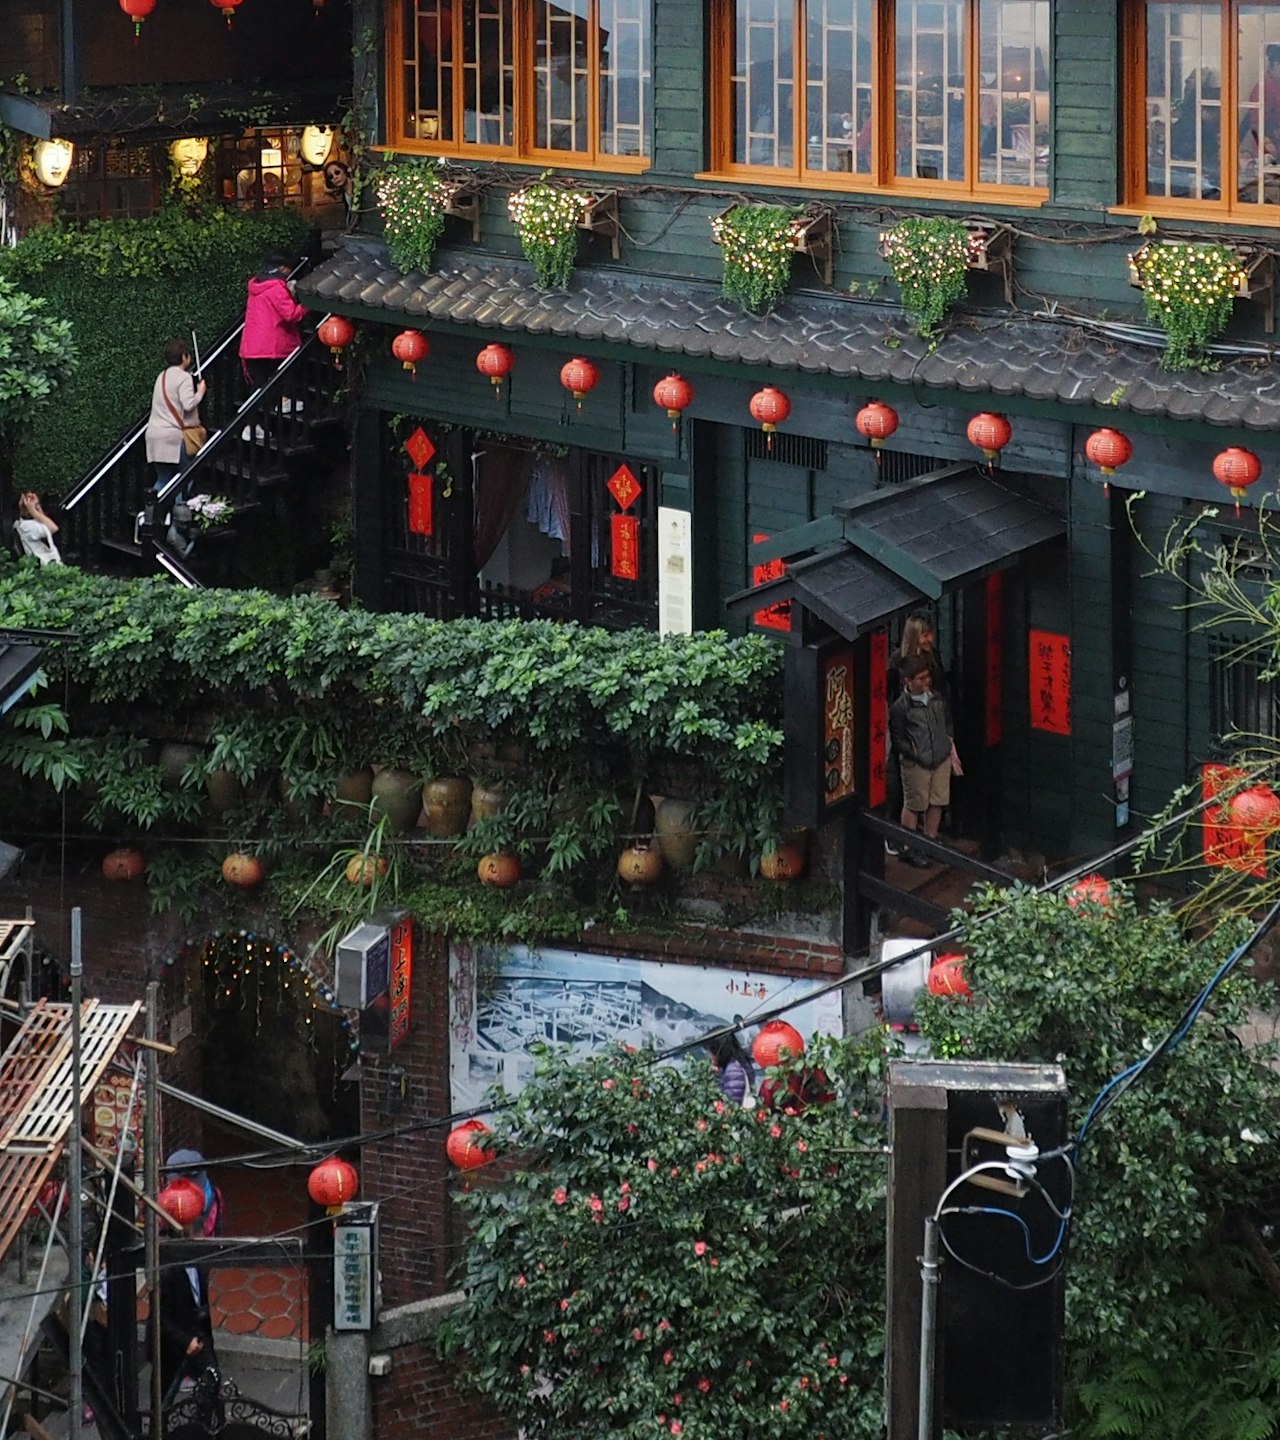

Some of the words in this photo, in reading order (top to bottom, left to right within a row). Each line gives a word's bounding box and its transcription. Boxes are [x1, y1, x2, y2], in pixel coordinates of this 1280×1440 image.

[393, 926, 408, 996] 小上海
[725, 978, 769, 1000] 小上海
